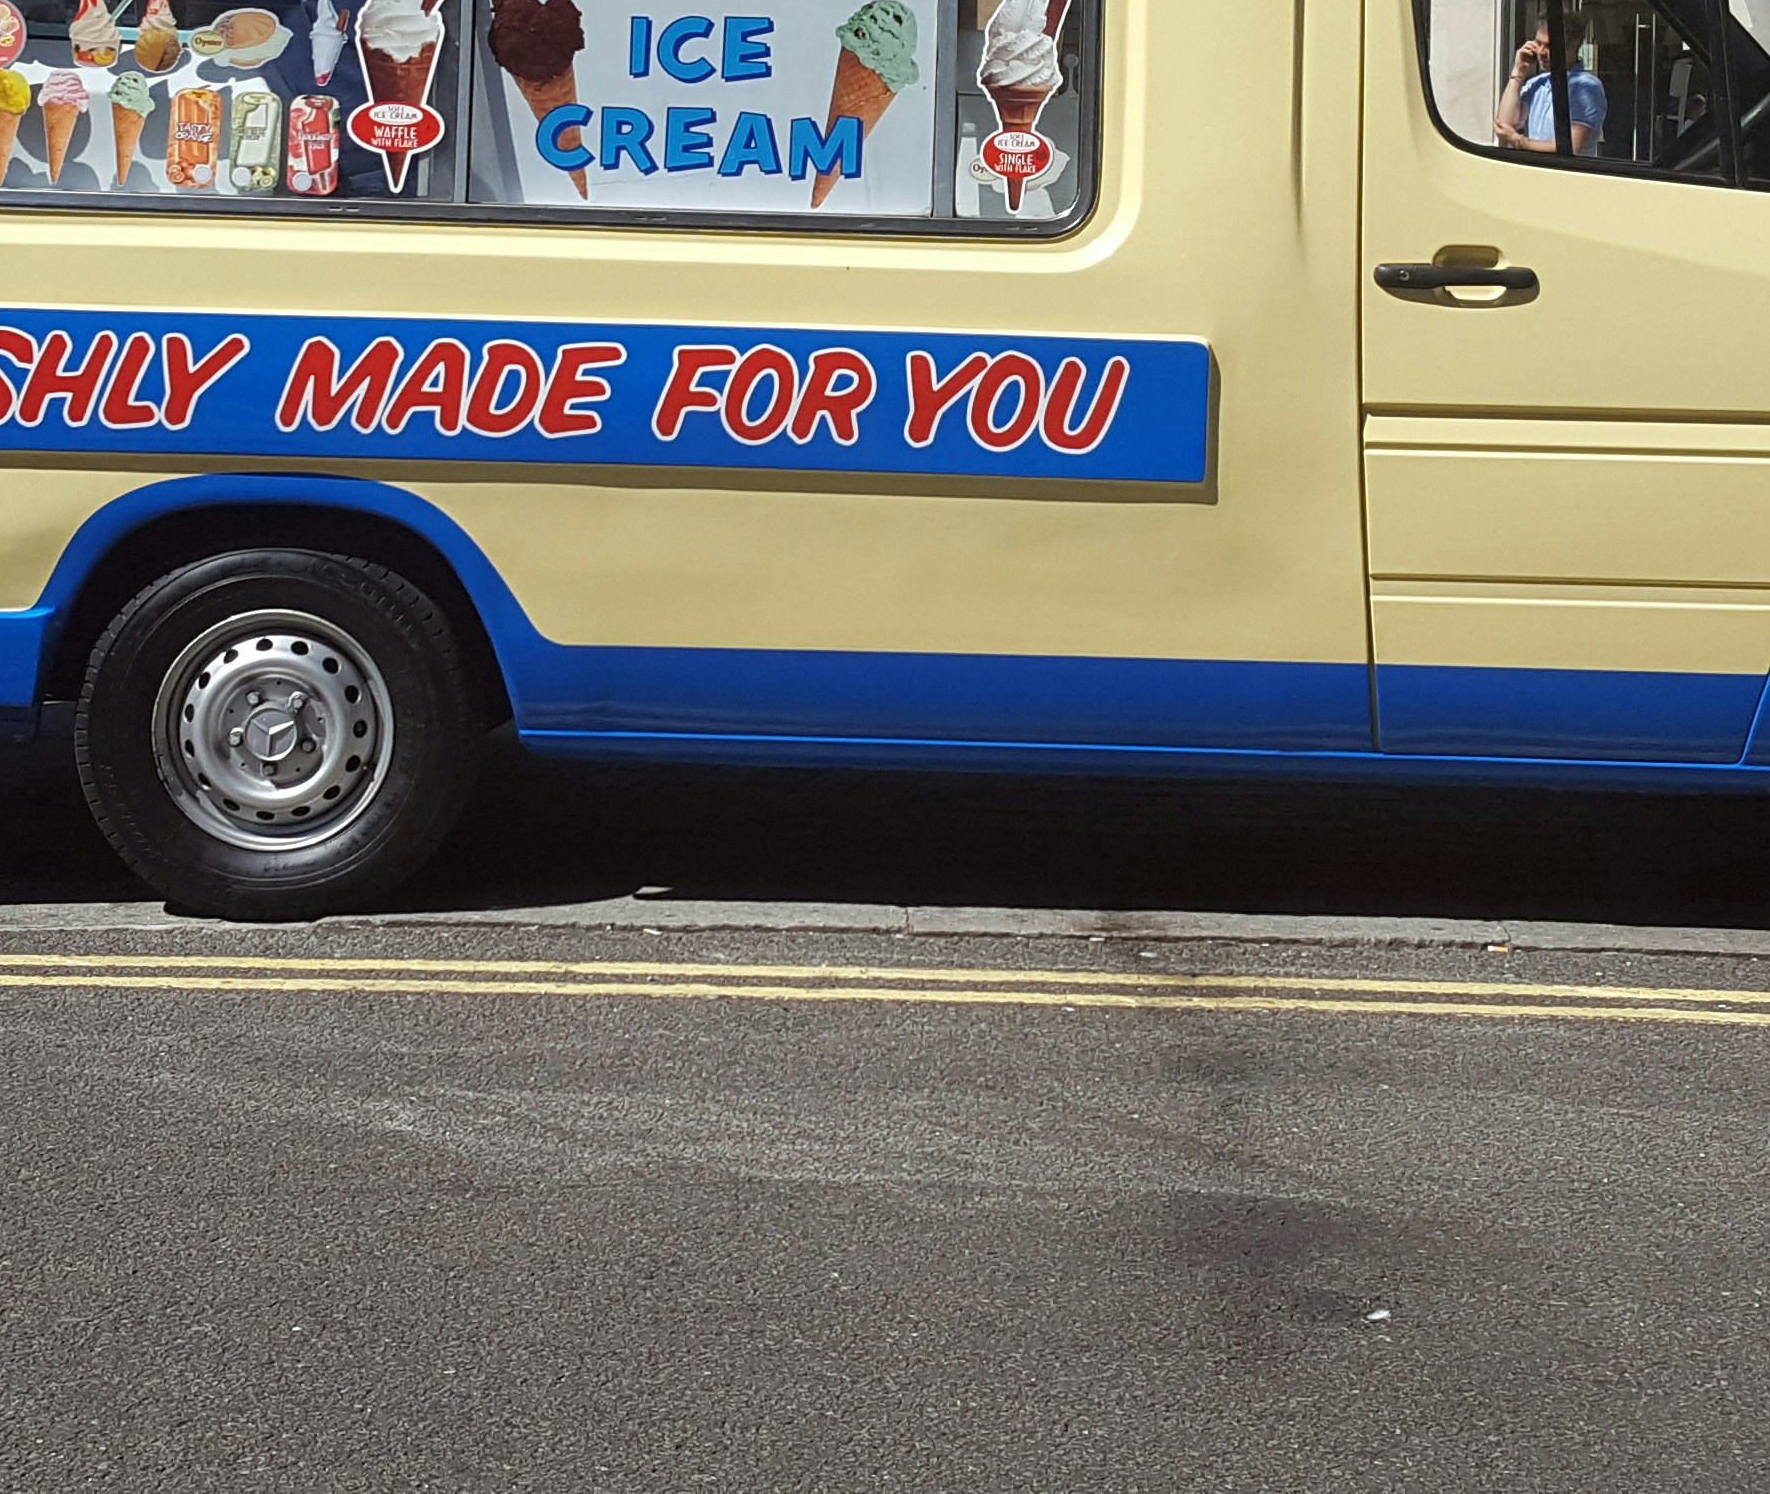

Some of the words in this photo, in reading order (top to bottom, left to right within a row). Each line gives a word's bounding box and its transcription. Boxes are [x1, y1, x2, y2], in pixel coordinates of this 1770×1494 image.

[194, 37, 223, 47] Oyster
[629, 15, 775, 84] ICE
[373, 111, 387, 119] ICE
[389, 111, 418, 120] CREAM
[178, 122, 212, 133] TASTY
[373, 125, 418, 139] WAFFLE
[174, 132, 215, 144] ORANGE
[370, 137, 392, 147] WITH
[394, 138, 419, 148] FLAKE
[535, 103, 865, 182] CREAM
[1011, 140, 1037, 148] CREAM
[998, 153, 1034, 166] SINGLE
[995, 164, 1014, 173] WITH
[1015, 164, 1038, 174] FLAKE
[278, 338, 625, 435] MADE
[654, 346, 876, 443] FOR
[906, 352, 1128, 452] YOU
